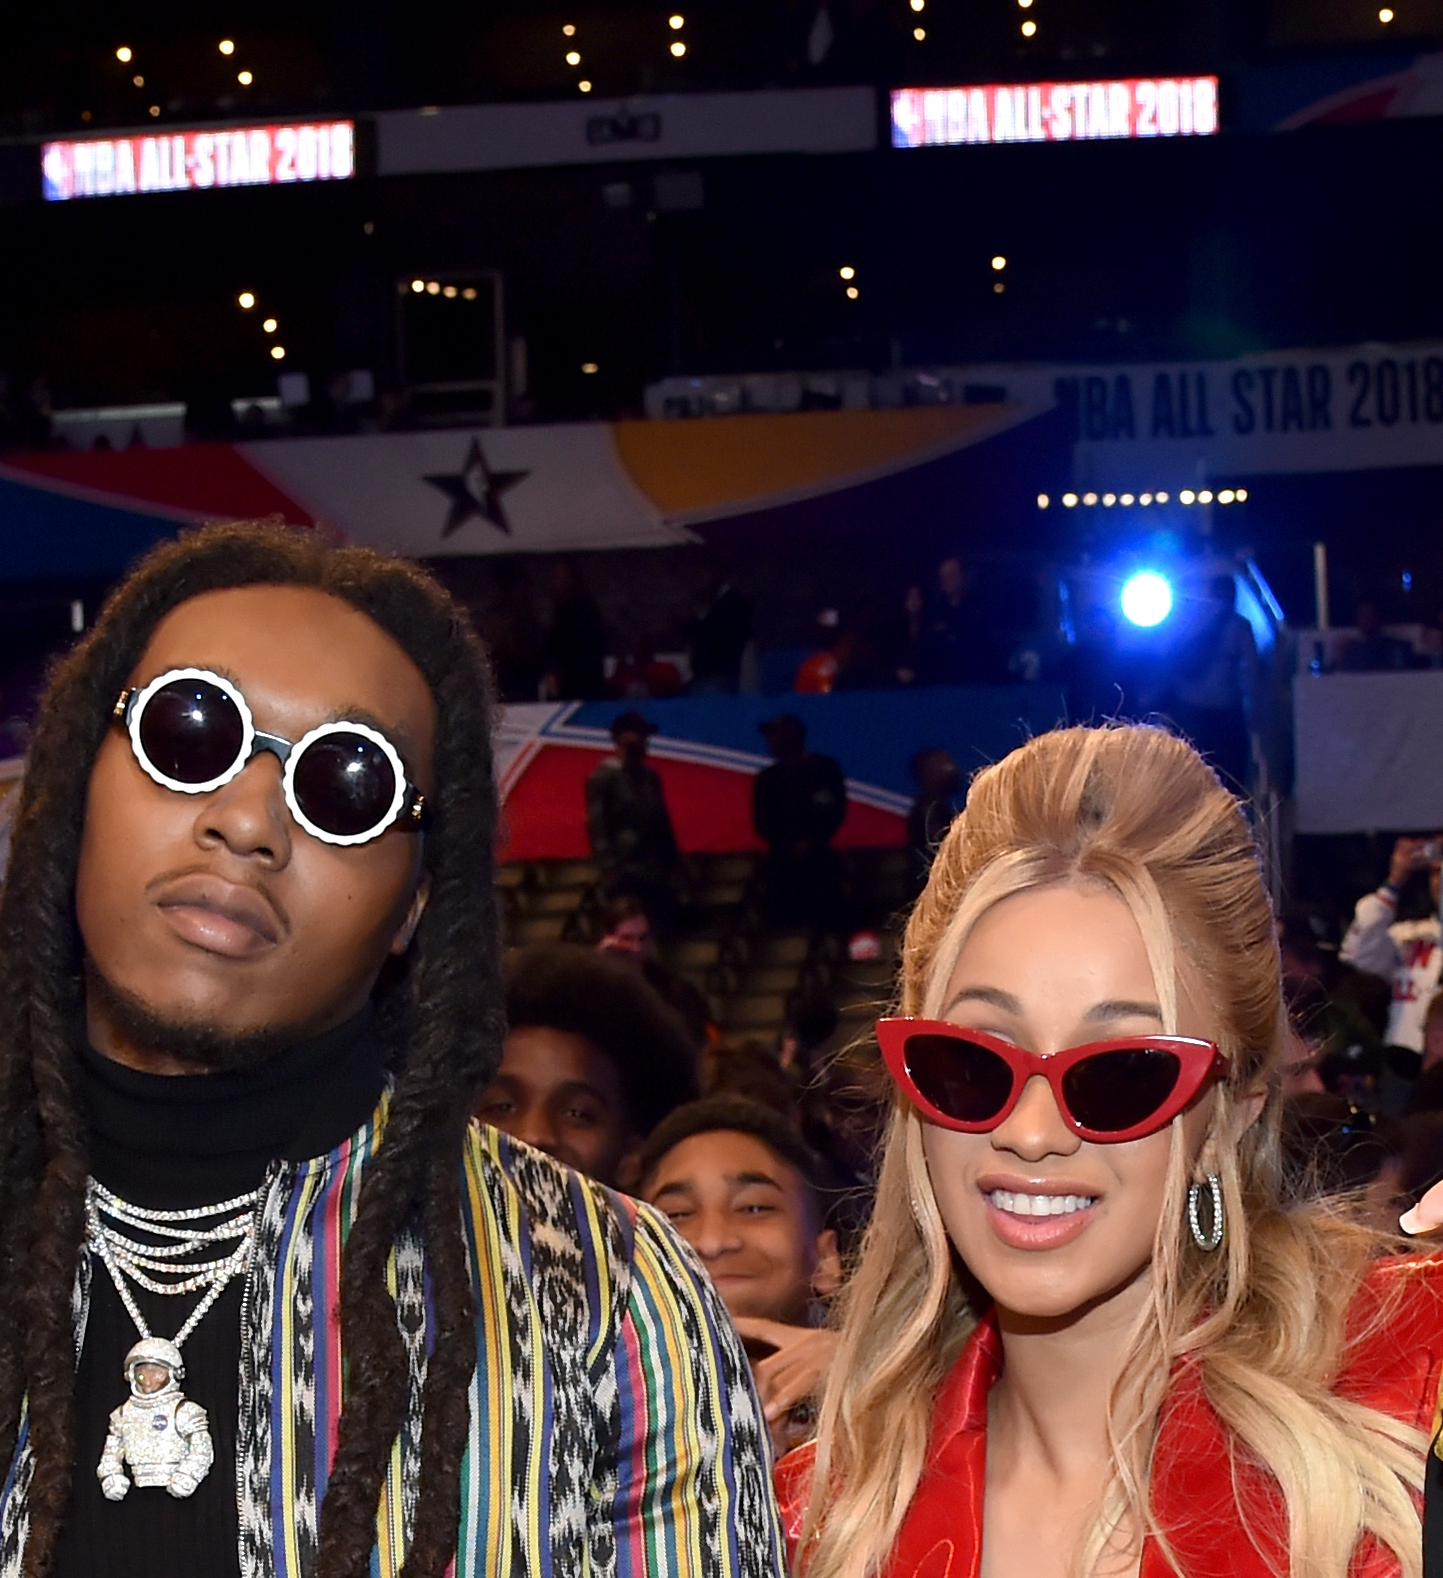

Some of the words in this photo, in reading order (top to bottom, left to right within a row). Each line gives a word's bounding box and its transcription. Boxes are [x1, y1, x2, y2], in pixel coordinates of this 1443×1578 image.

[1134, 78, 1218, 137] 2018
[273, 122, 353, 182] 2018
[1150, 371, 1214, 438] ALL
[1231, 364, 1333, 435] STAR
